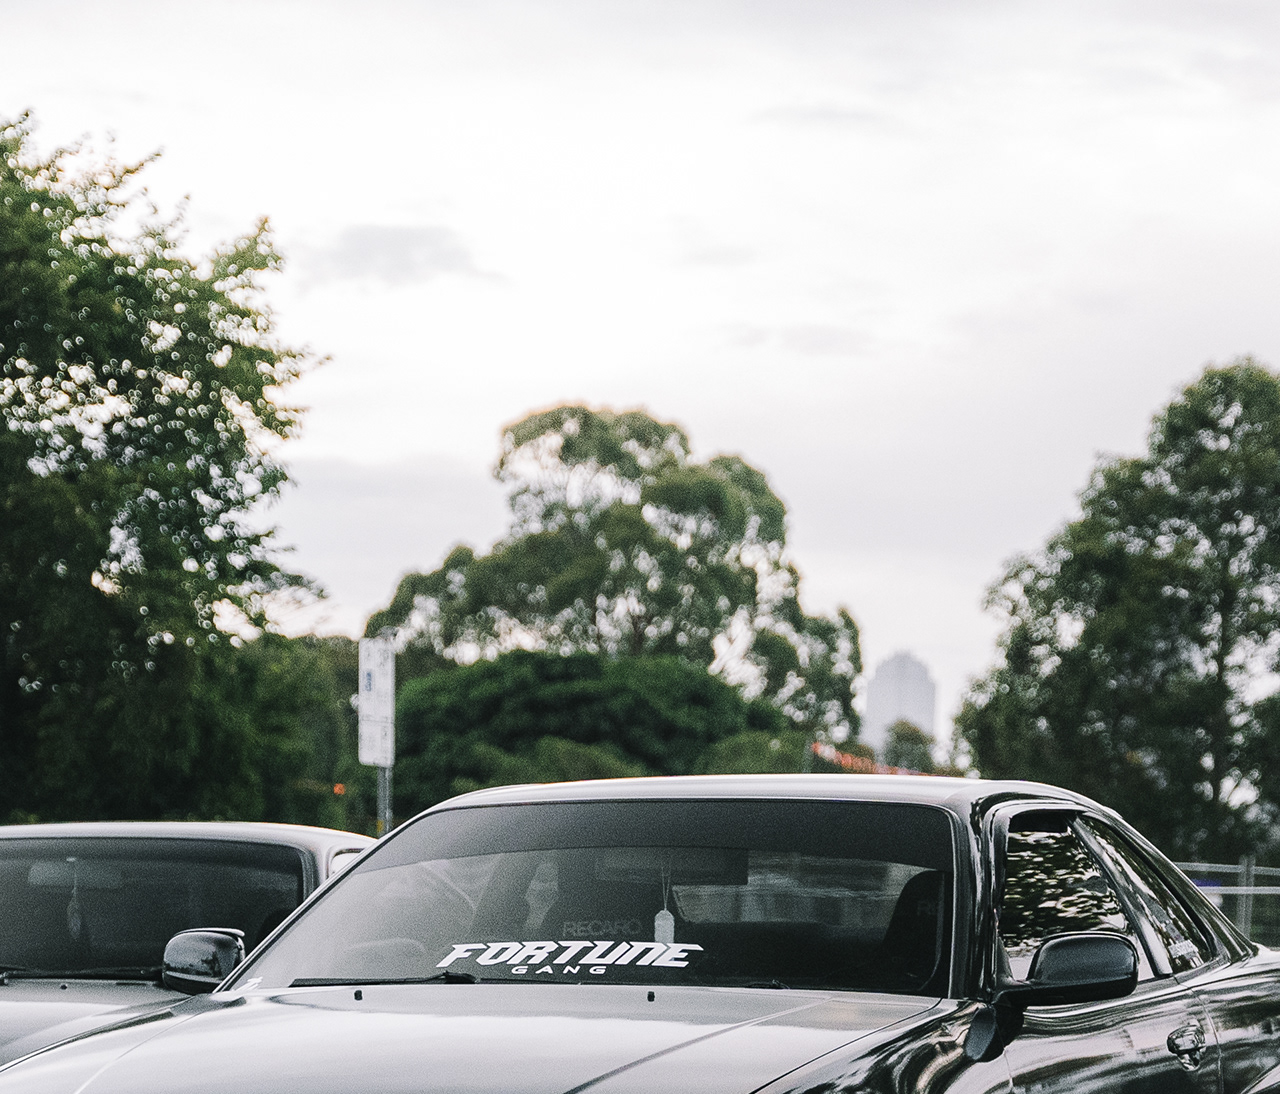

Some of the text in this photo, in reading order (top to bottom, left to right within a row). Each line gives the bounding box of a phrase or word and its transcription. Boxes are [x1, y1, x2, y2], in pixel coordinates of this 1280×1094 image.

[562, 918, 642, 937] RECARO
[435, 940, 704, 968] FORTUNE
[511, 965, 608, 975] GANG
